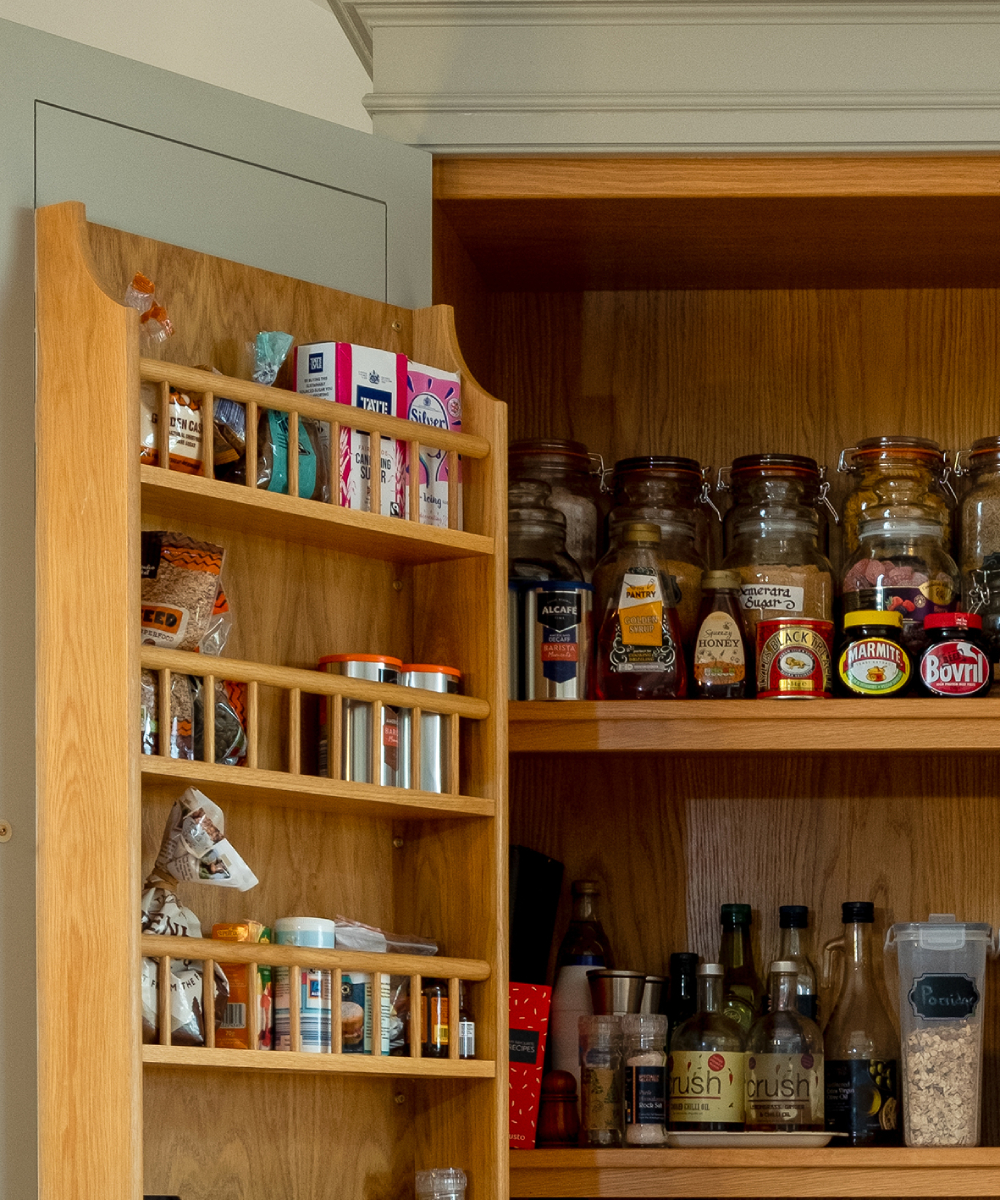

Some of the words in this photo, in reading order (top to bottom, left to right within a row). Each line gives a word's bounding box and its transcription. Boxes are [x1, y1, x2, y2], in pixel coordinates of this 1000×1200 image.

[360, 396, 388, 414] TATE
[152, 413, 187, 430] GDEN
[411, 408, 446, 428] Silver
[360, 466, 386, 484] SUR
[424, 493, 442, 508] Icing
[626, 591, 656, 599] PANTRY
[745, 596, 787, 609] Sugar
[141, 608, 178, 628] EED
[624, 616, 658, 624] GOLDEN
[629, 625, 655, 634] SYRUP
[704, 629, 732, 640] Squeezy
[543, 644, 576, 652] BARISTA
[699, 639, 740, 648] HONEY
[770, 631, 808, 652] BLACK
[848, 642, 902, 662] MARMITE
[942, 652, 962, 662] BEEF
[926, 652, 984, 683] Bovril
[181, 976, 196, 990] THE
[747, 1072, 810, 1098] crush
